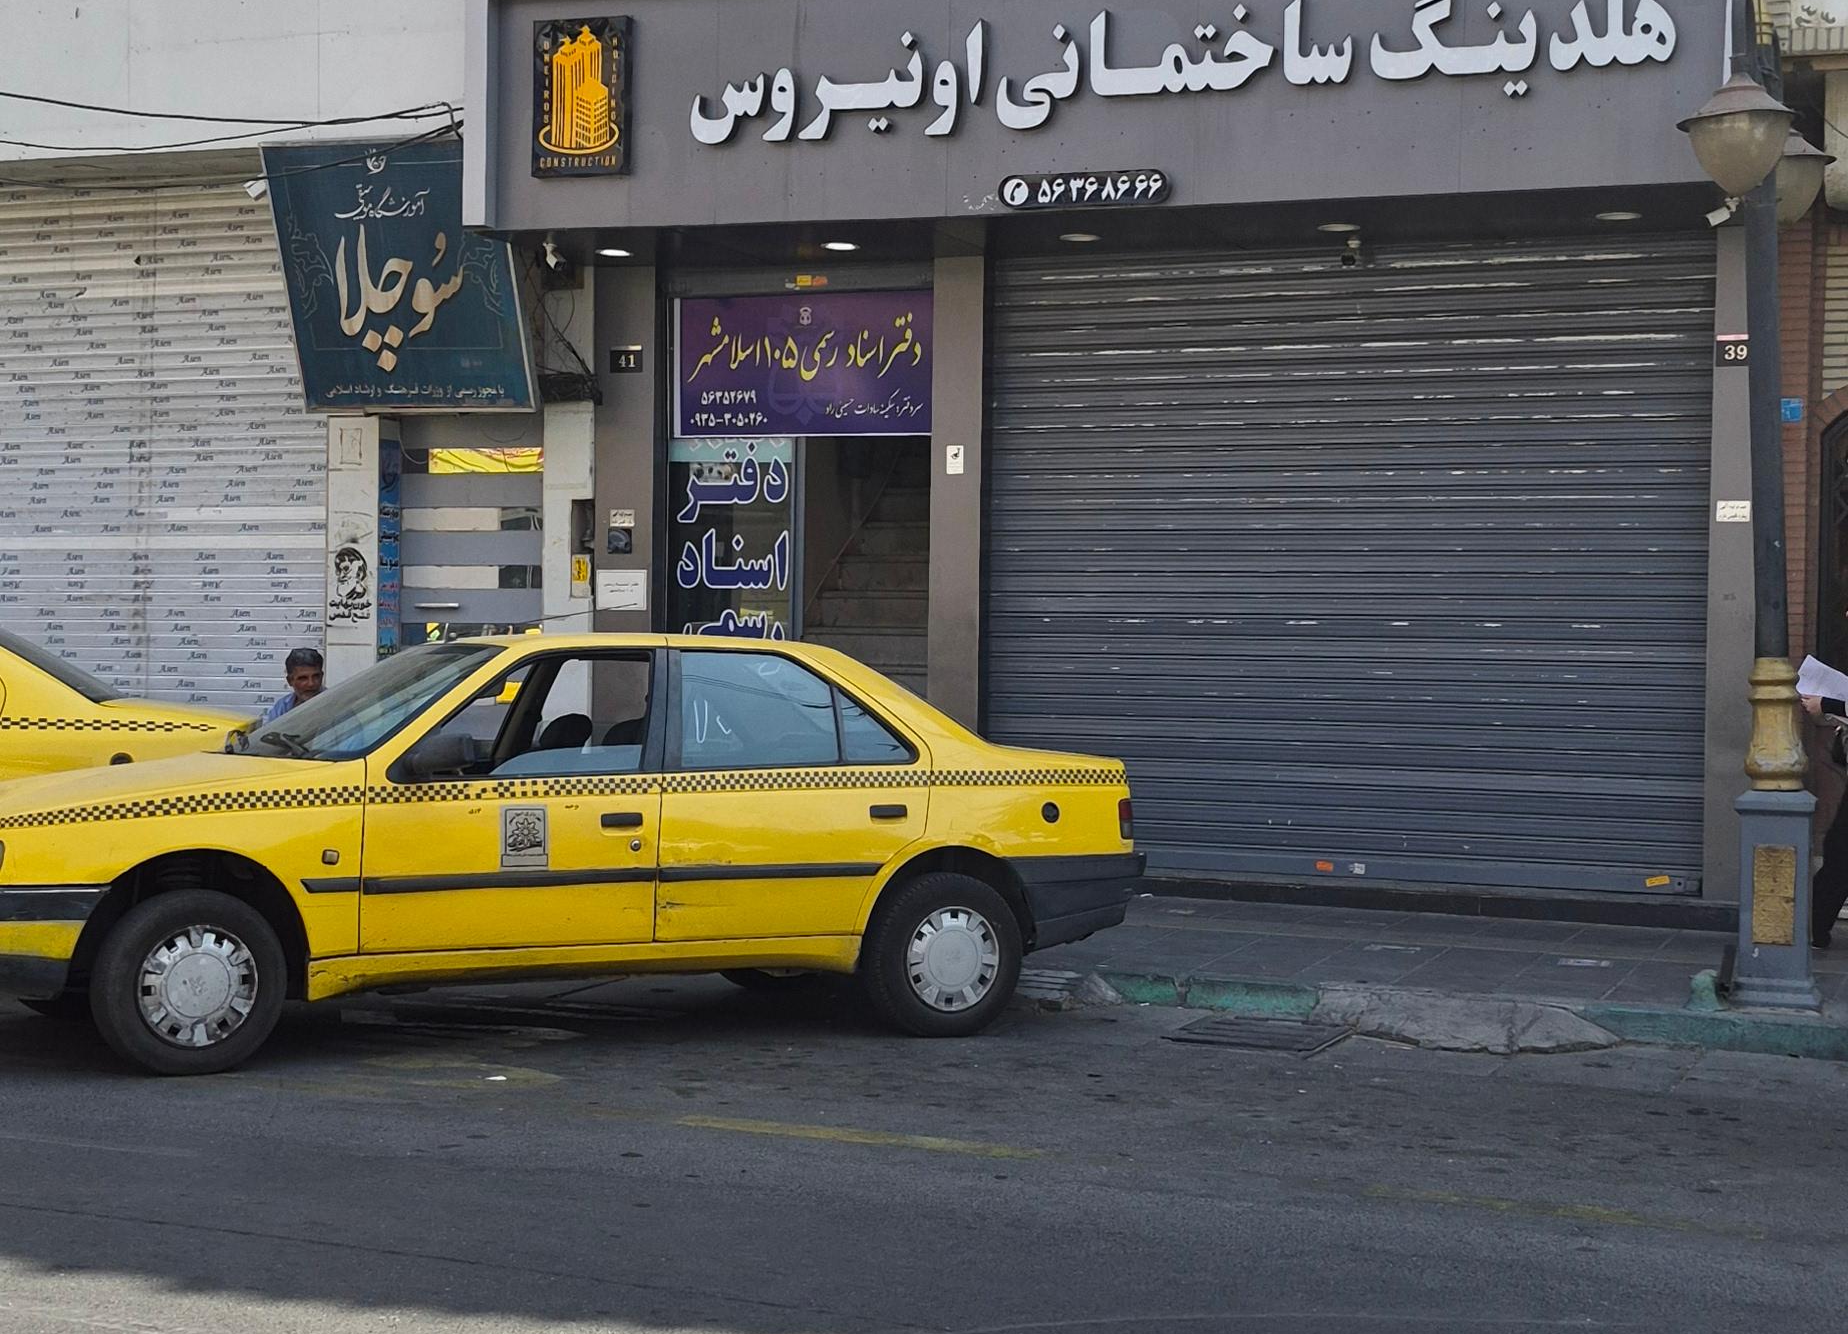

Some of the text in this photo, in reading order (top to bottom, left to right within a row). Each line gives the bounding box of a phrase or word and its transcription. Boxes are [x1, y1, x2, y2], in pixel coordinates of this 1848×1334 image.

[689, 17, 987, 147] اونیروس
[538, 154, 617, 169] CONSTRUCTION
[618, 354, 637, 368] 41
[687, 312, 922, 383] دفتر اسناد رسمی ۱۰۵ اسلامشهر
[1724, 344, 1748, 361] 39
[700, 389, 758, 406] ۵۶۳۵۲۶۷۹
[676, 441, 789, 524] دفتر
[676, 528, 790, 592] اسناد
